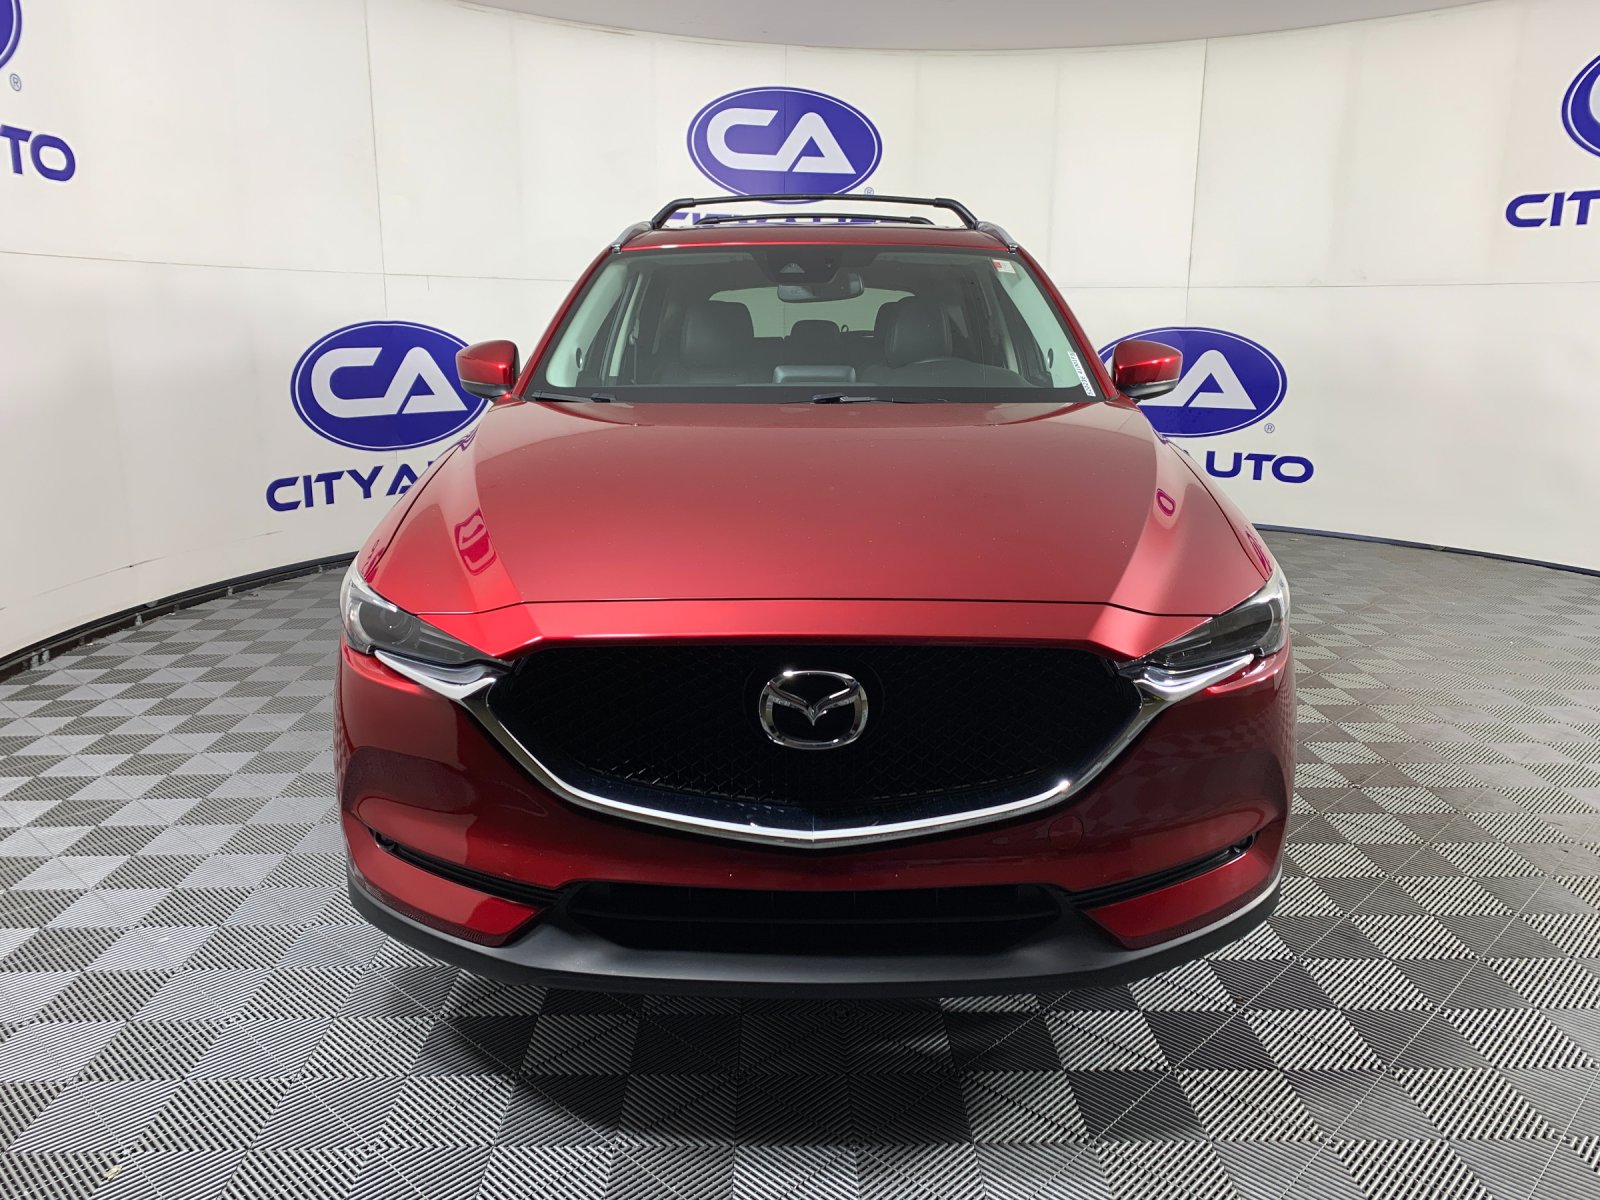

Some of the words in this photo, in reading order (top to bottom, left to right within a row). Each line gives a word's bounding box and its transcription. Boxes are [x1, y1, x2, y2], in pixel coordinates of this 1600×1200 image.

[706, 107, 857, 174] CA
[310, 346, 468, 418] CA
[1184, 449, 1314, 483] UTO
